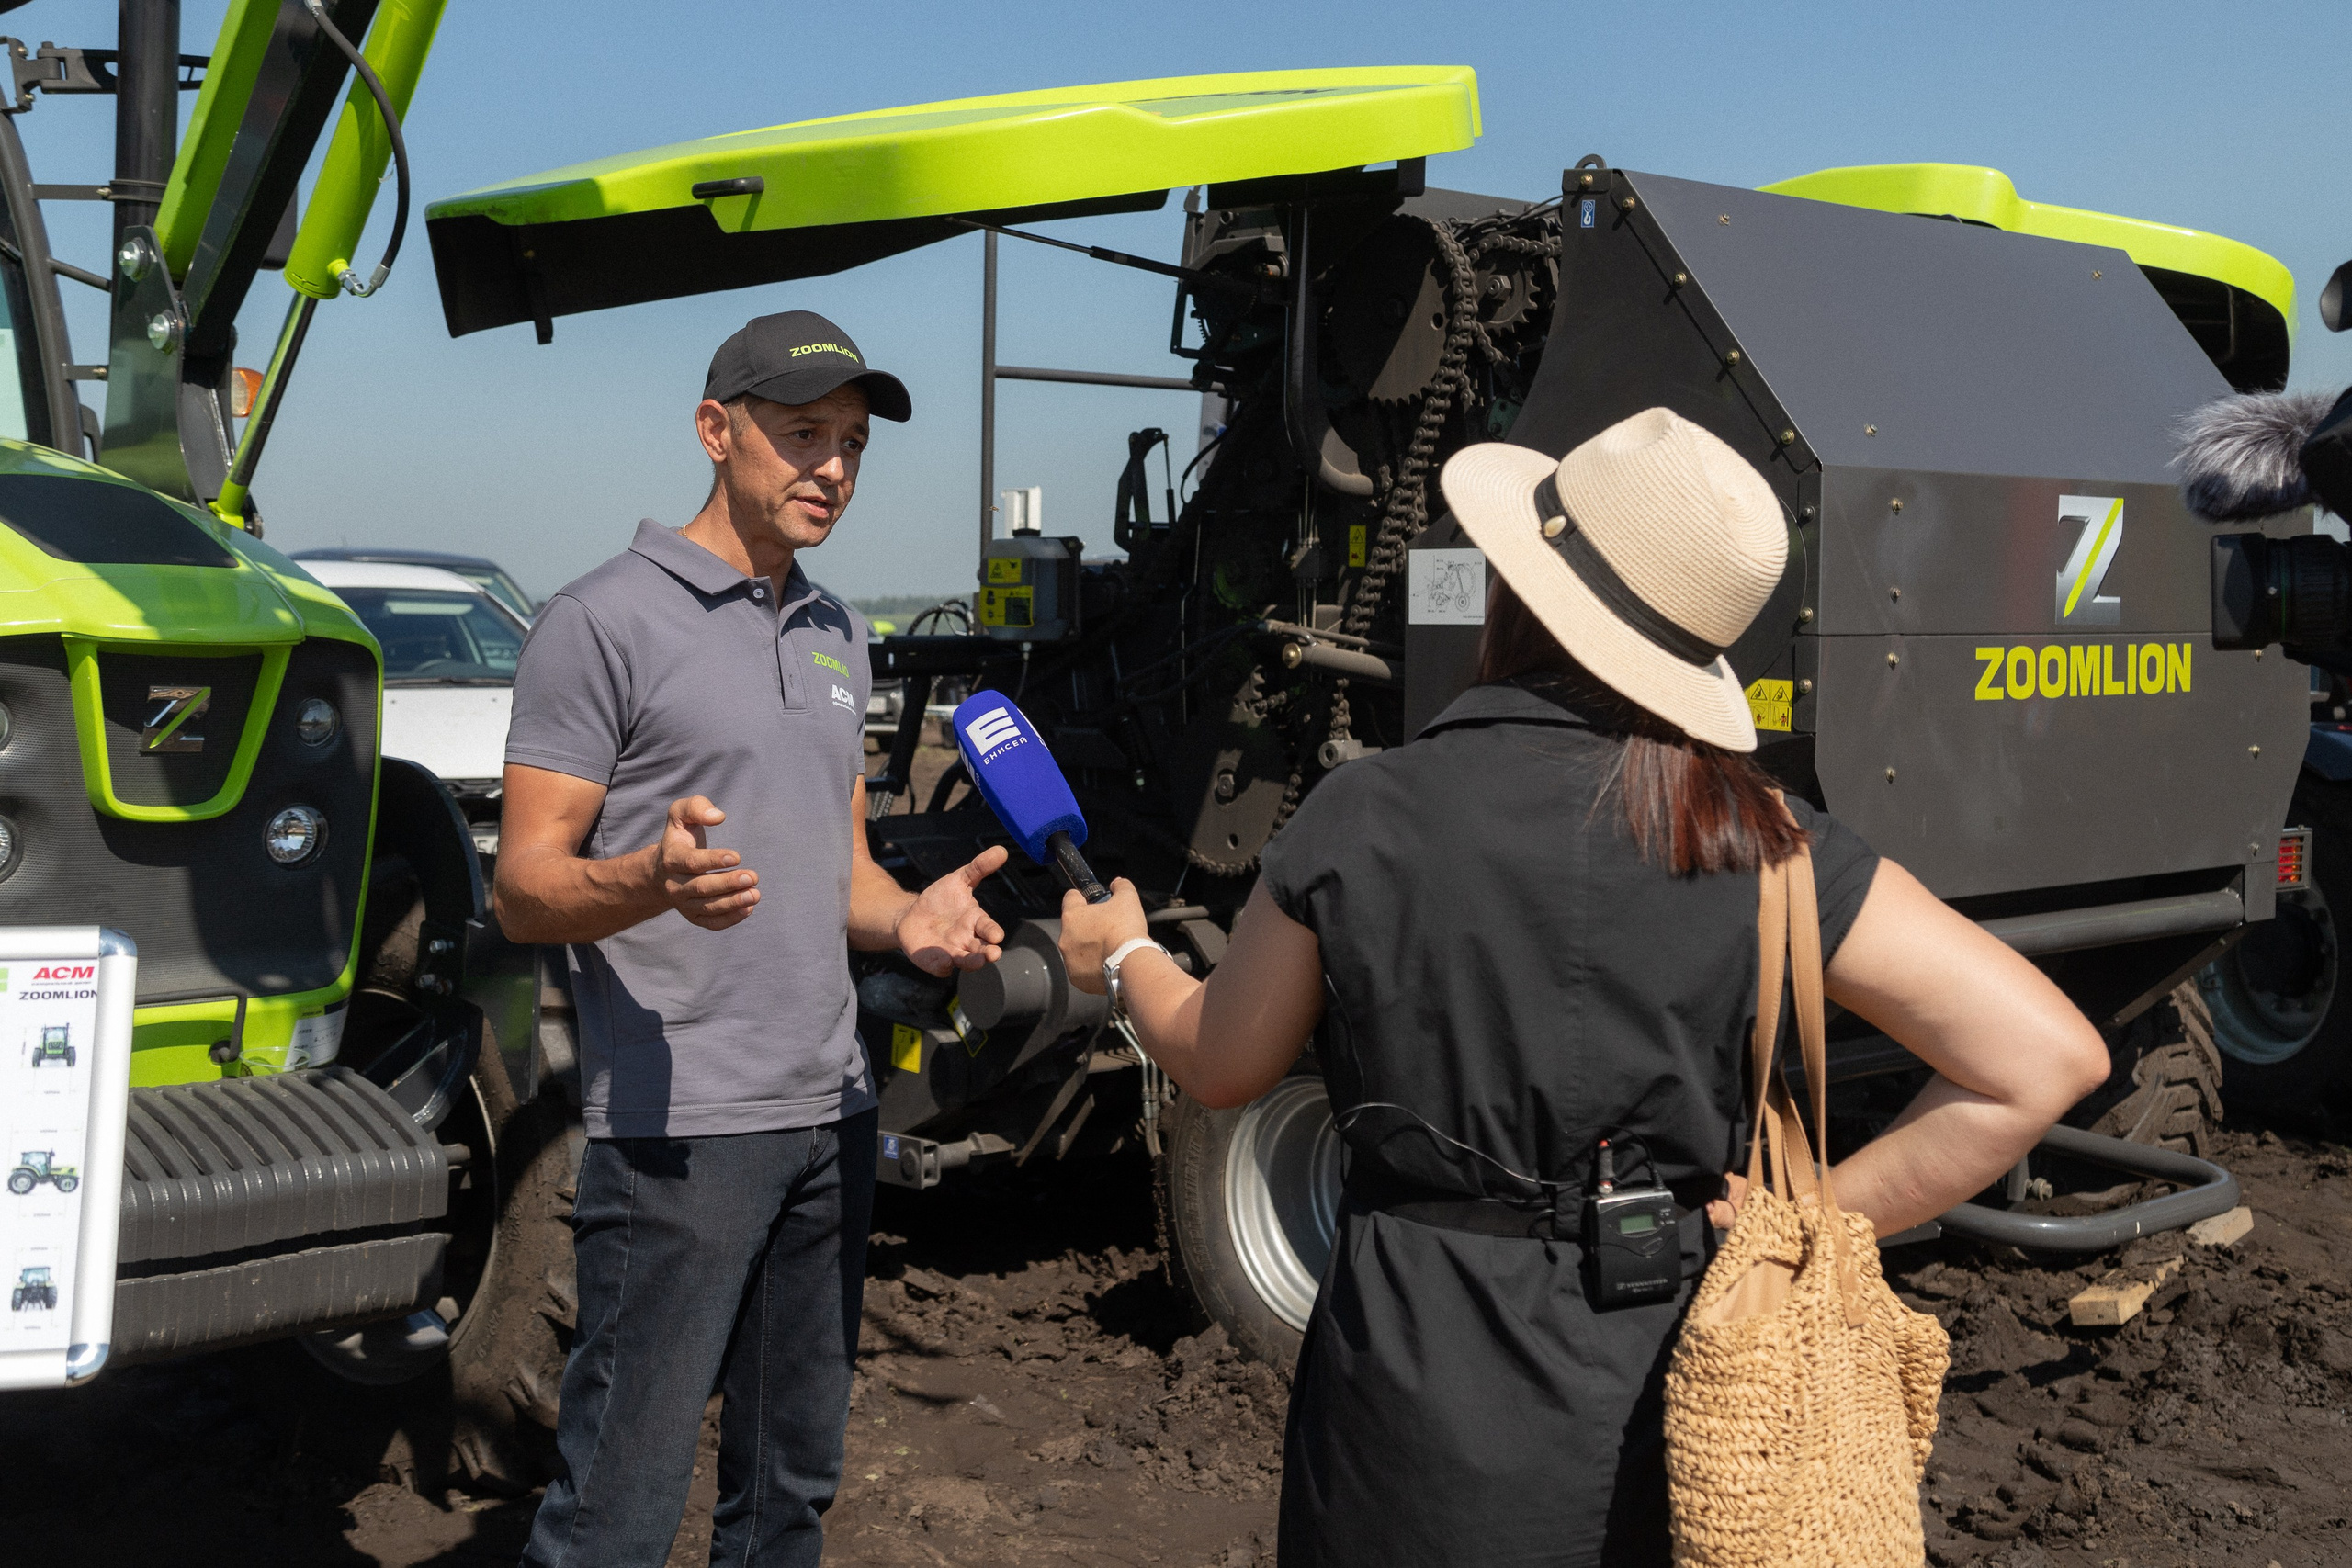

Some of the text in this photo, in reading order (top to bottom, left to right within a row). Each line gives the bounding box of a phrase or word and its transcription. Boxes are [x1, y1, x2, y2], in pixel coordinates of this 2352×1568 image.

[789, 343, 860, 364] ZOOMLION
[811, 651, 850, 679] ZOOMLIO
[1974, 643, 2192, 701] ZOOMLION
[983, 736, 1028, 765] ЕНИСЕЙ
